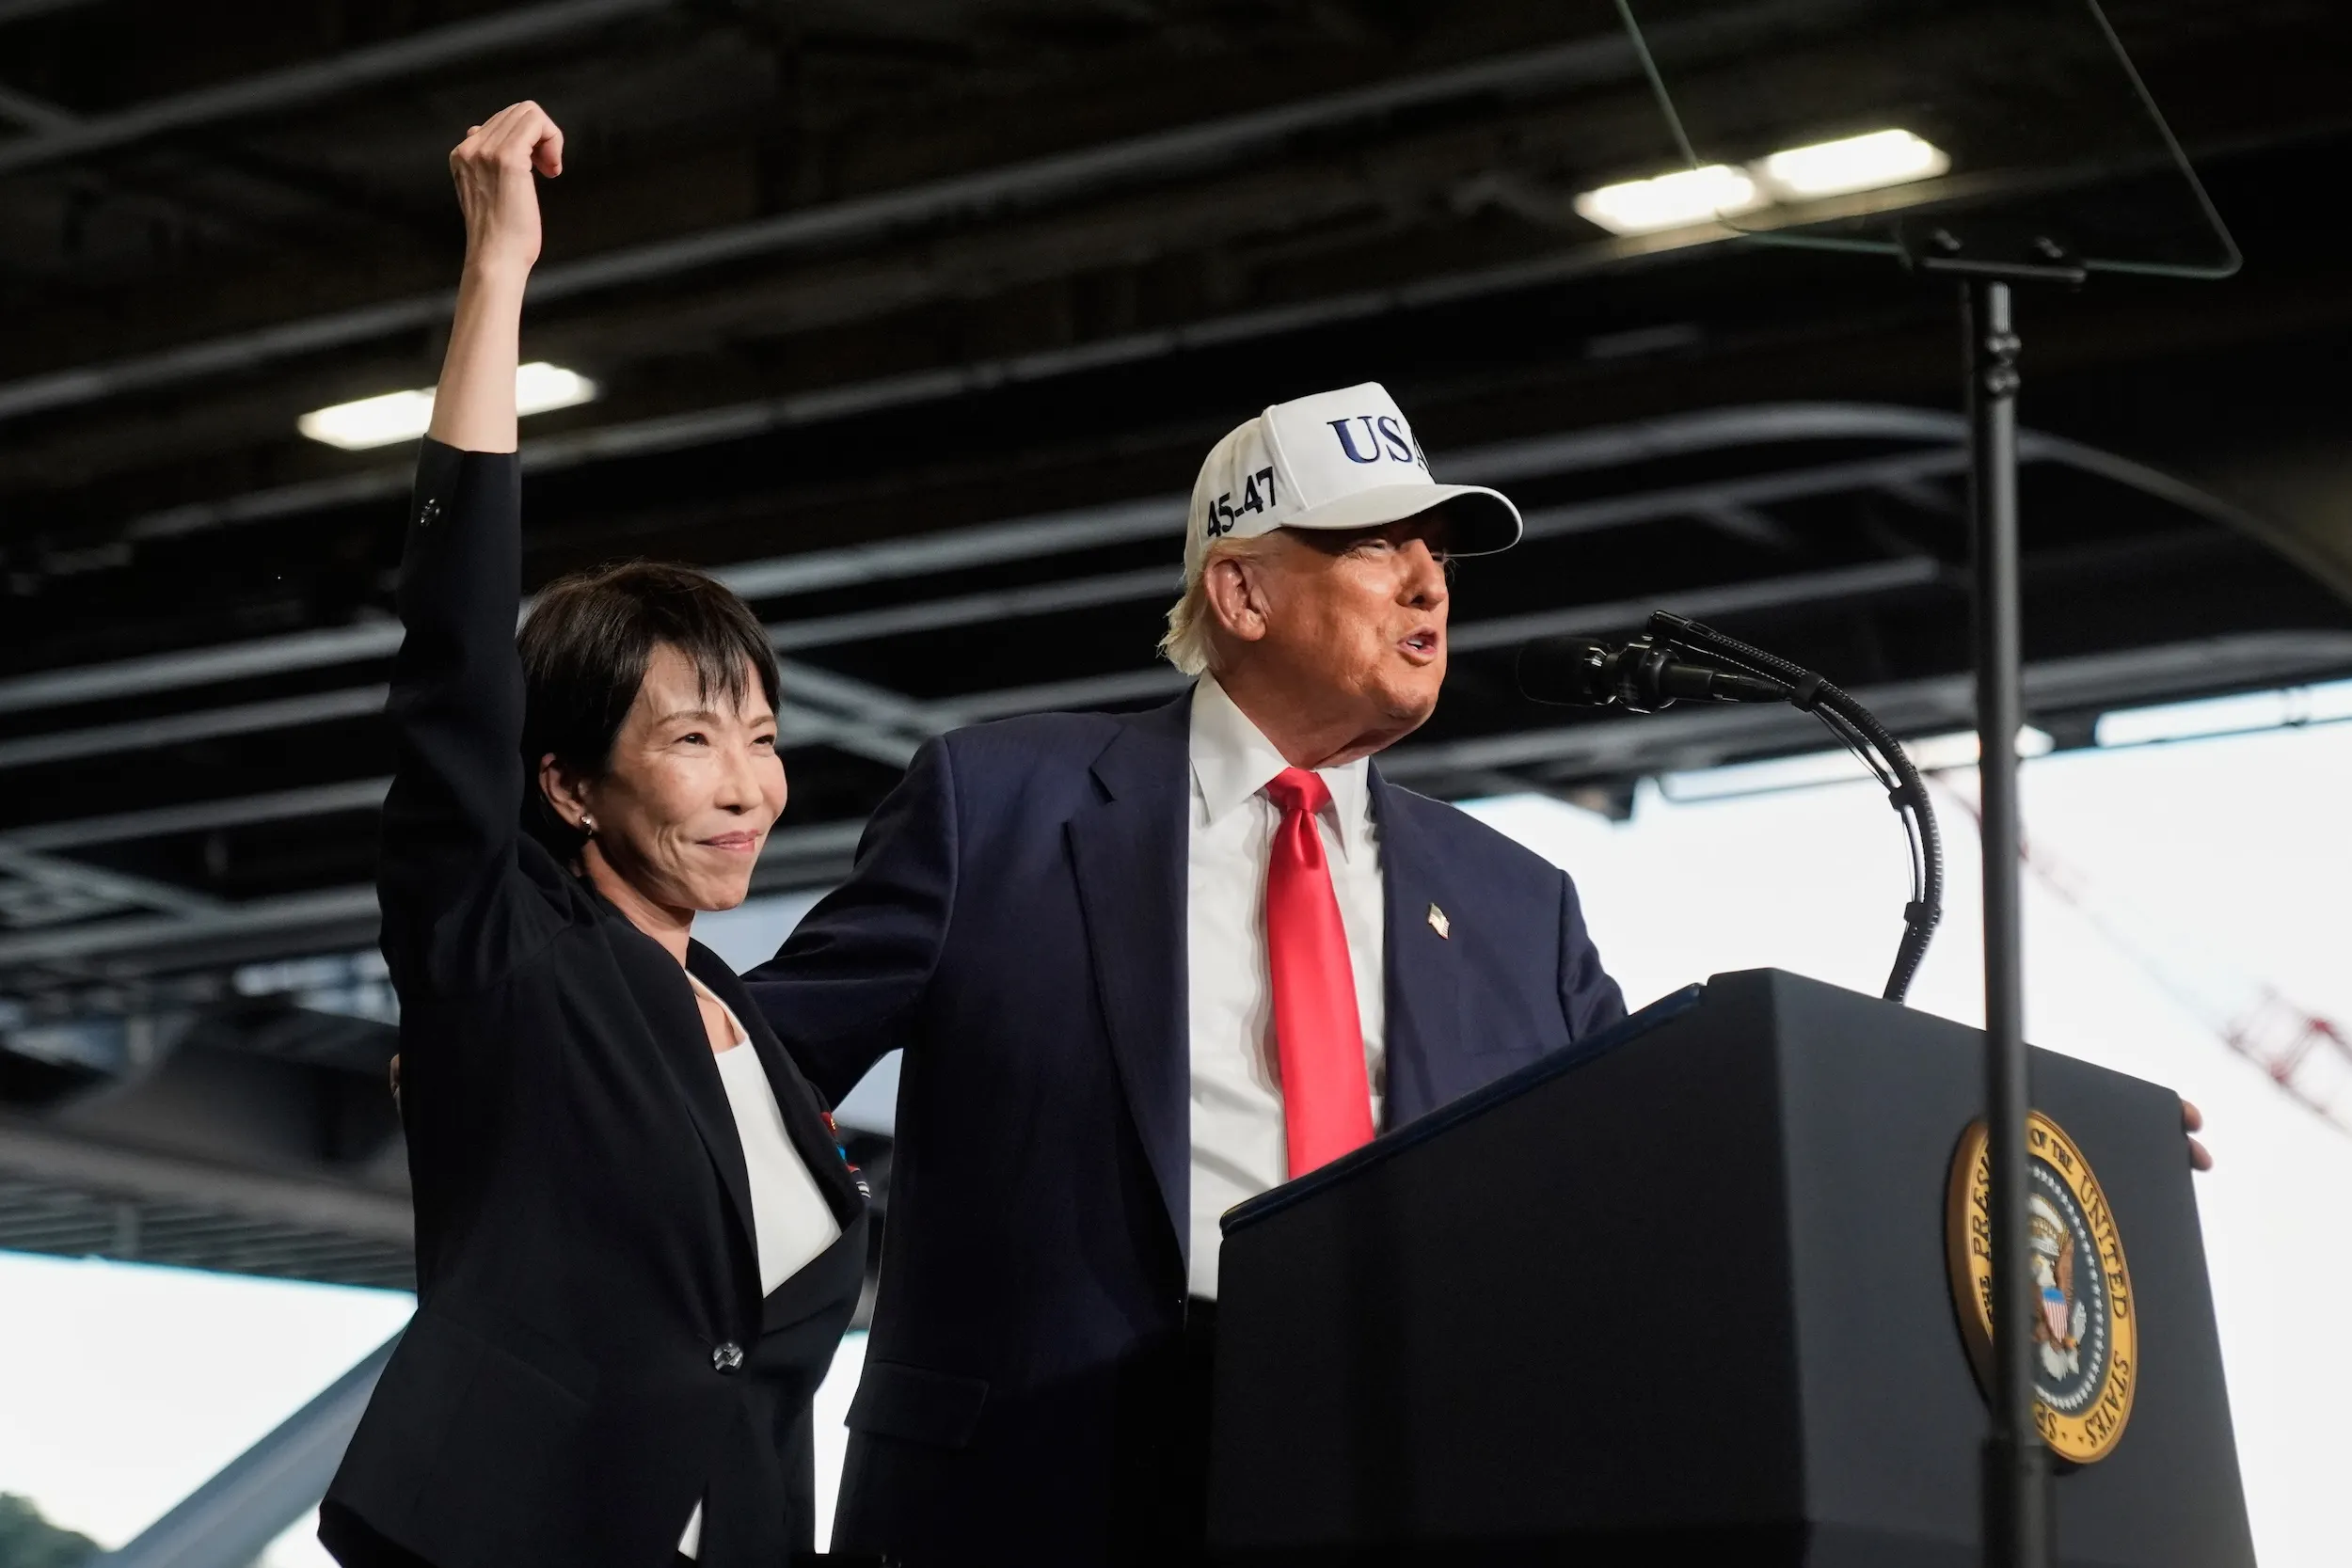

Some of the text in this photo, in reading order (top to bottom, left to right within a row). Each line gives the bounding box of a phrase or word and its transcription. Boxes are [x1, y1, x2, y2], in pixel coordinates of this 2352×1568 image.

[1207, 467, 1276, 537] 45-47
[2051, 1138, 2074, 1175] THE
[1973, 1148, 1991, 1261] PRESI
[2080, 1175, 2127, 1320] UNITED
[2035, 1401, 2058, 1440] SE
[2084, 1350, 2129, 1449] STATES
